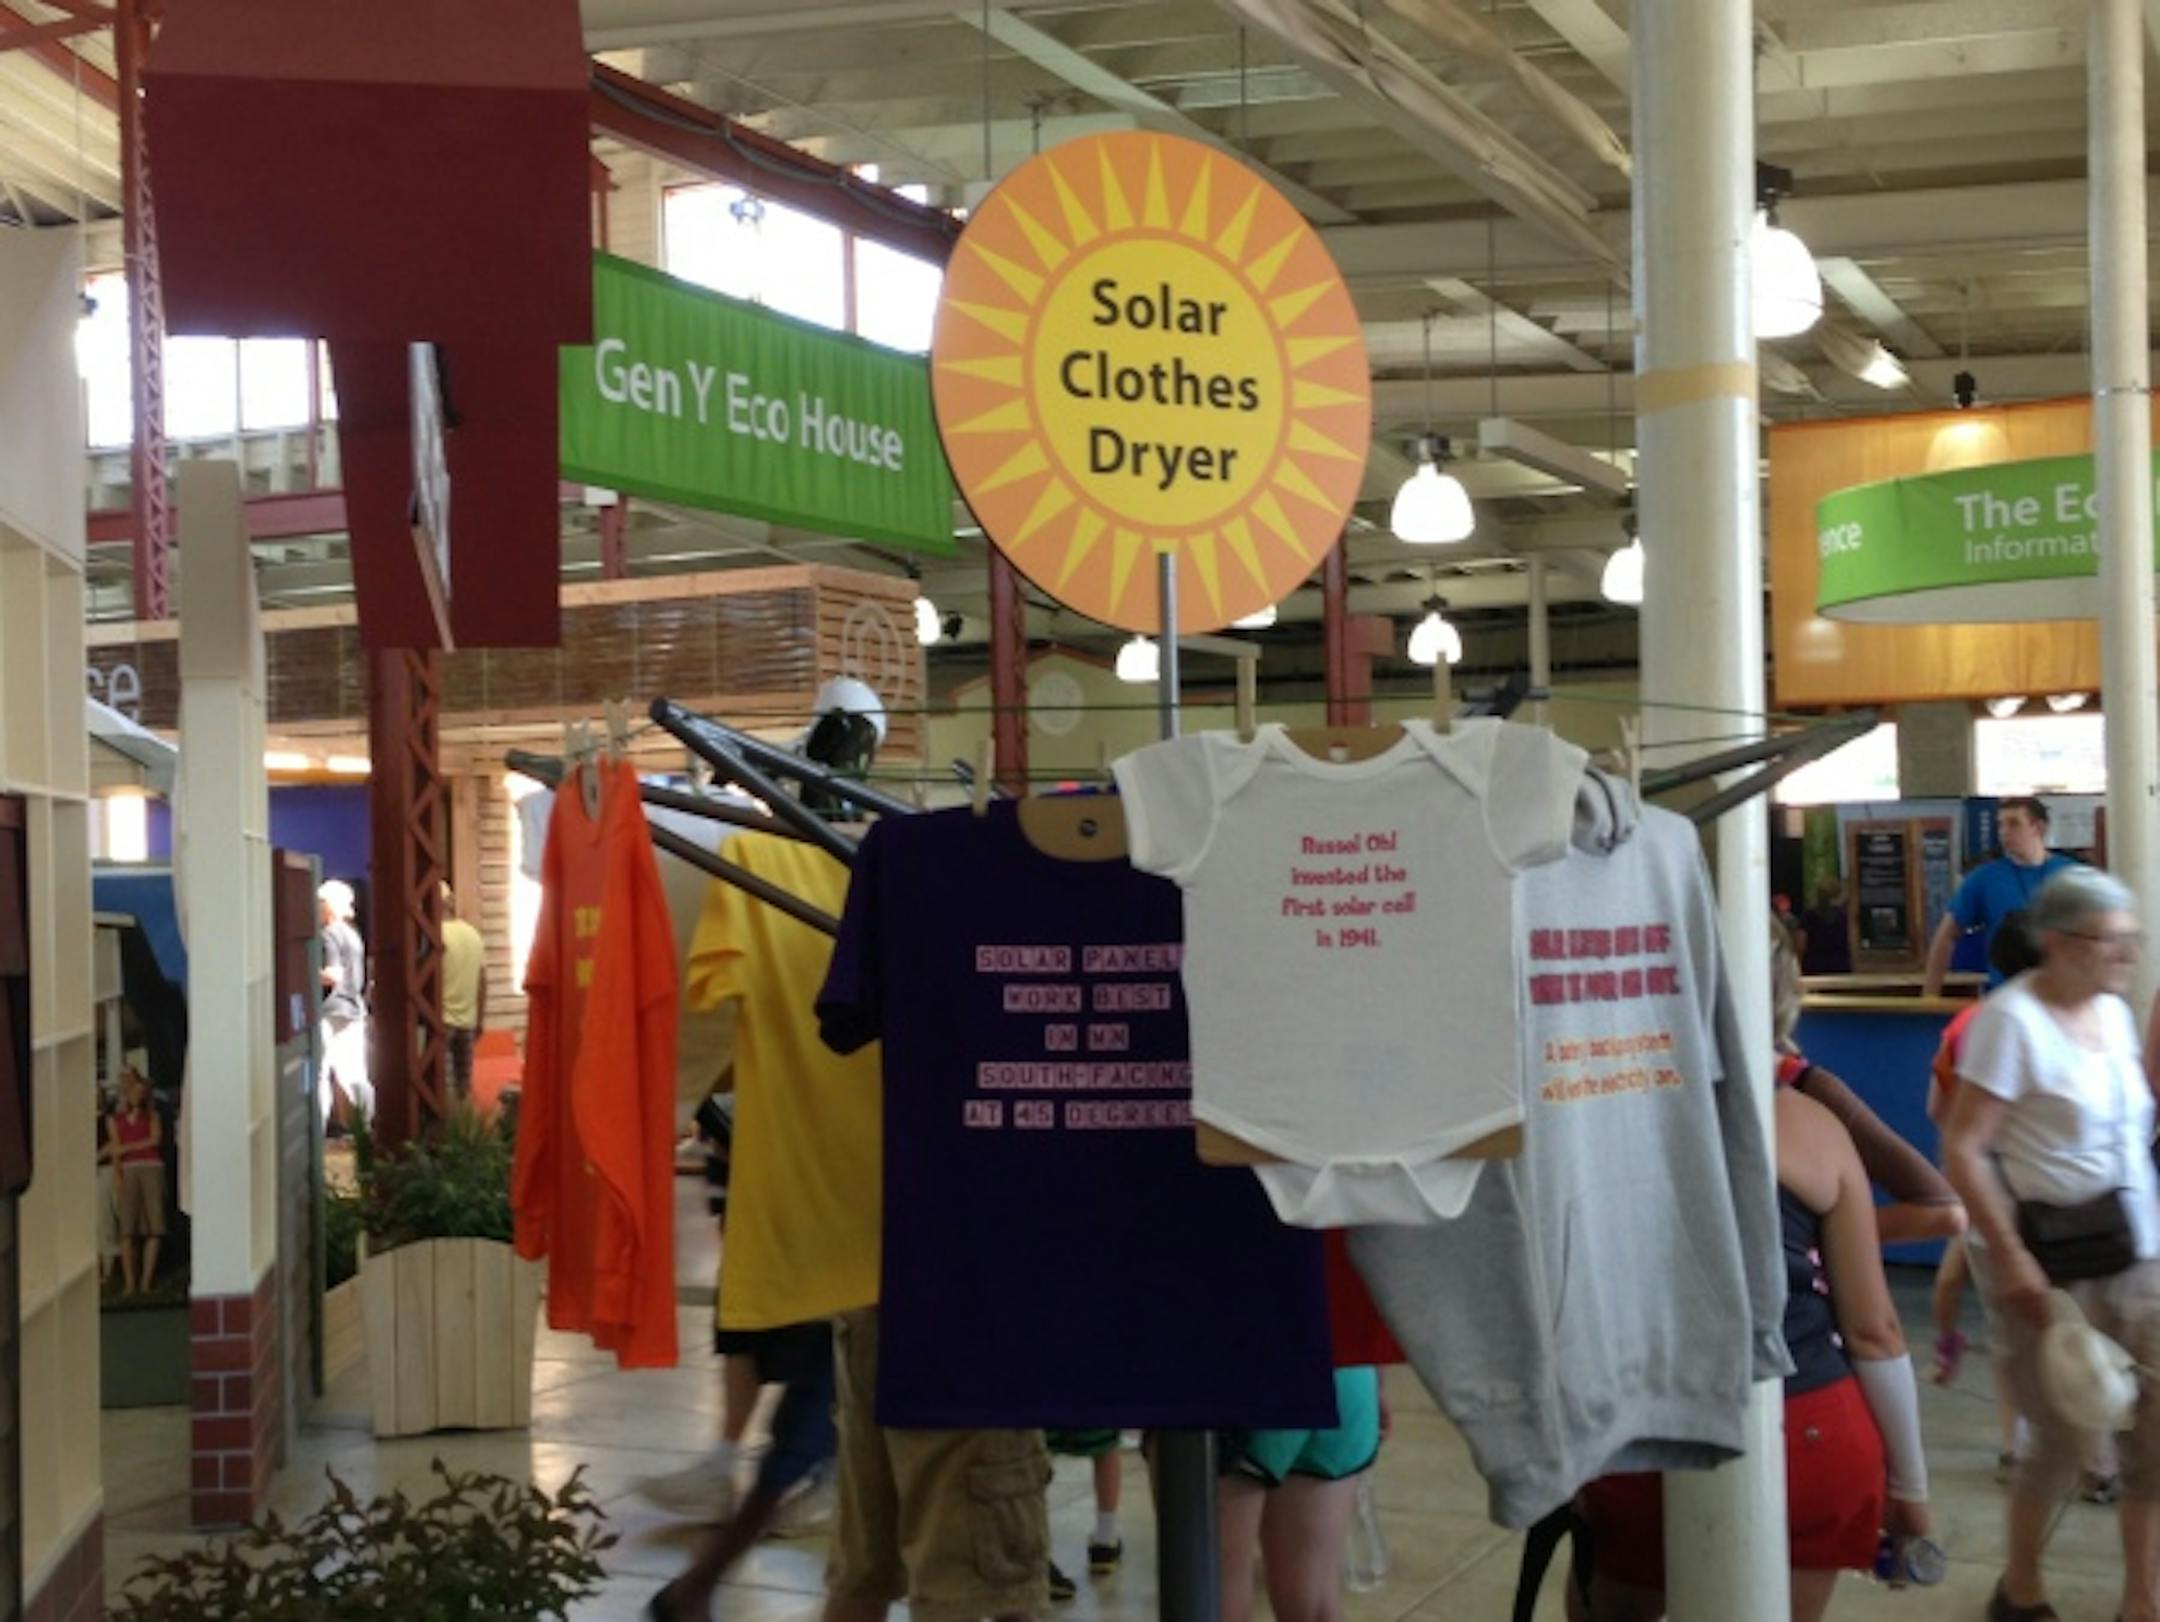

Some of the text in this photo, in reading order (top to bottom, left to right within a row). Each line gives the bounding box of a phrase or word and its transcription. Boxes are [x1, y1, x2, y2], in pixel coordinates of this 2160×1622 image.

[1092, 278, 1228, 336] Solar
[1060, 350, 1260, 412] Clothes
[595, 338, 904, 471] Gen Y Eco House
[1089, 425, 1239, 491] Dryer
[1955, 491, 2040, 532] The
[1290, 864, 1407, 886] invented the
[1332, 895, 1375, 917] solar
[1380, 890, 1416, 914] cell
[976, 945, 1071, 972] SOLAR
[1003, 984, 1171, 1012] WORK BEST
[1045, 1024, 1077, 1050] IN
[964, 1100, 1003, 1127] AT
[1013, 1101, 1054, 1129] 45
